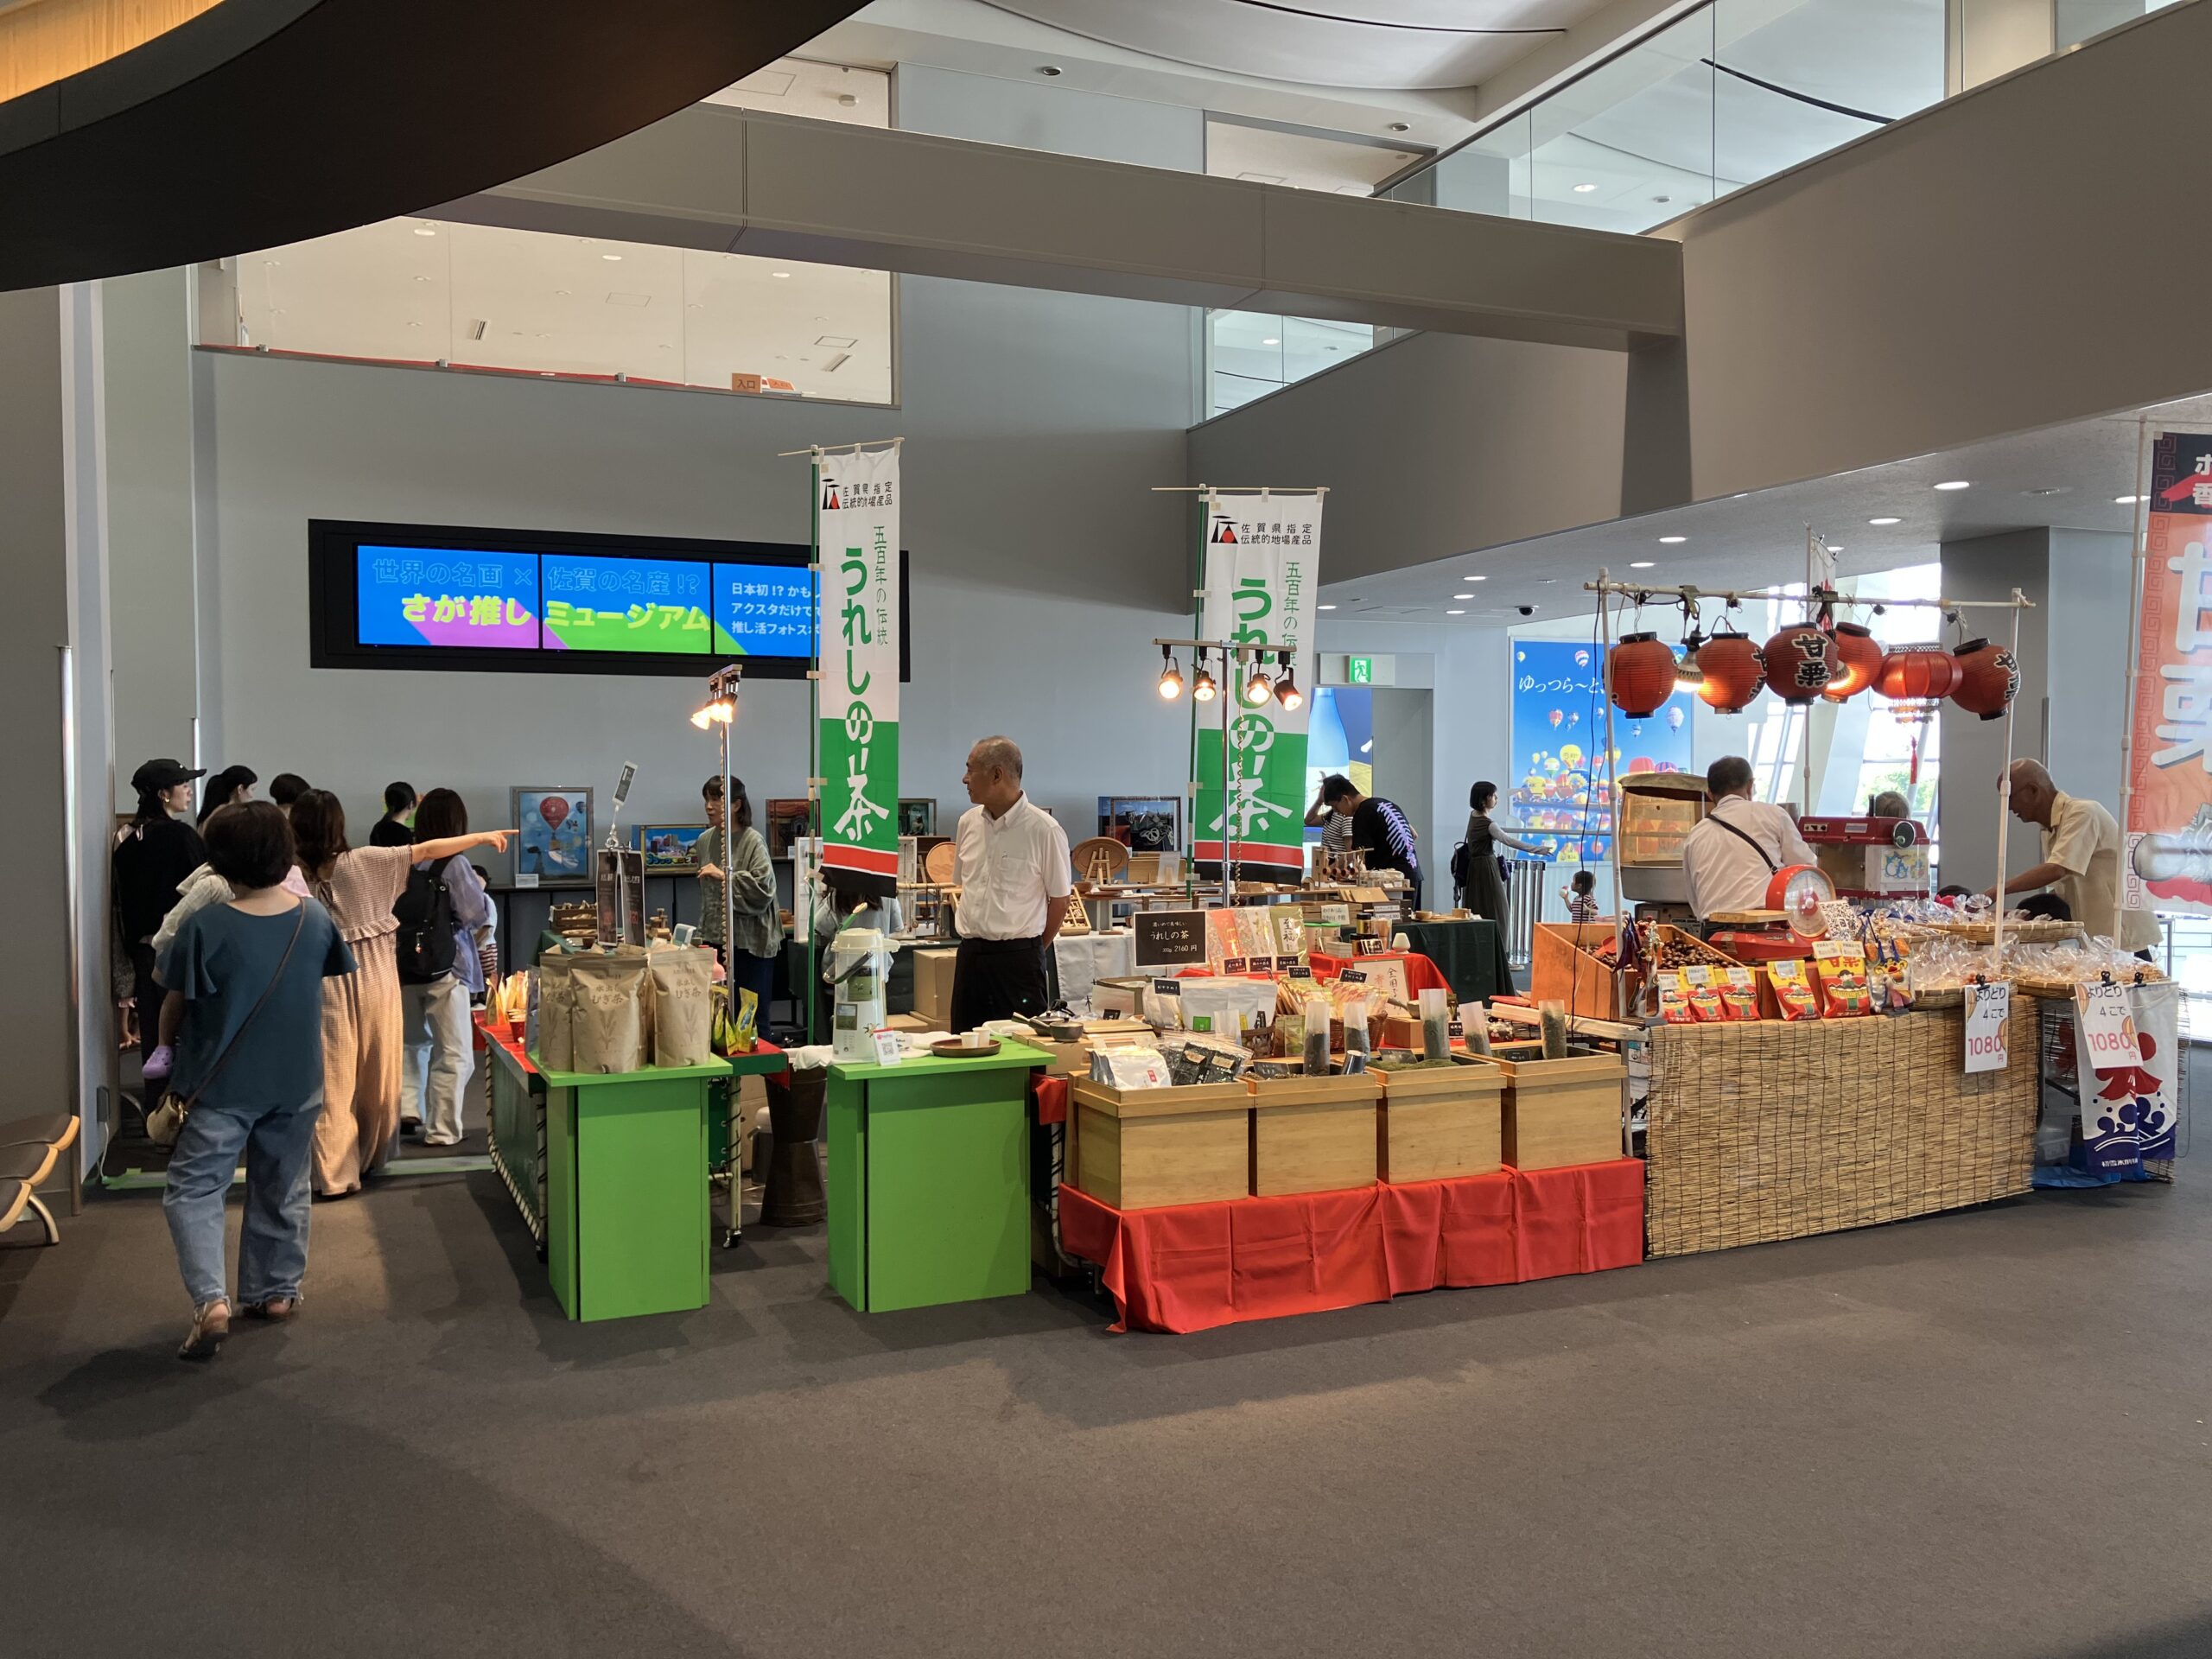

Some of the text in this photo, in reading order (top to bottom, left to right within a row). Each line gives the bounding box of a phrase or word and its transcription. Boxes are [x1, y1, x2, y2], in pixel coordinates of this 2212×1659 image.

[736, 378, 755, 389] 入口
[1241, 523, 1313, 535] 佐賀県指定
[1240, 534, 1313, 545] 伝統的地場産品
[372, 558, 503, 588] 世界の名画
[873, 525, 888, 645] 五百年の伝統
[1281, 562, 1302, 667] 五百年の伝
[1791, 633, 1832, 688] 甘栗
[833, 547, 890, 842] うれしの茶
[1150, 930, 1189, 941] うれしの茶
[1976, 987, 2006, 1002] よりどり
[1968, 1035, 2002, 1056] 1080
[2088, 1032, 2132, 1052] 1080
